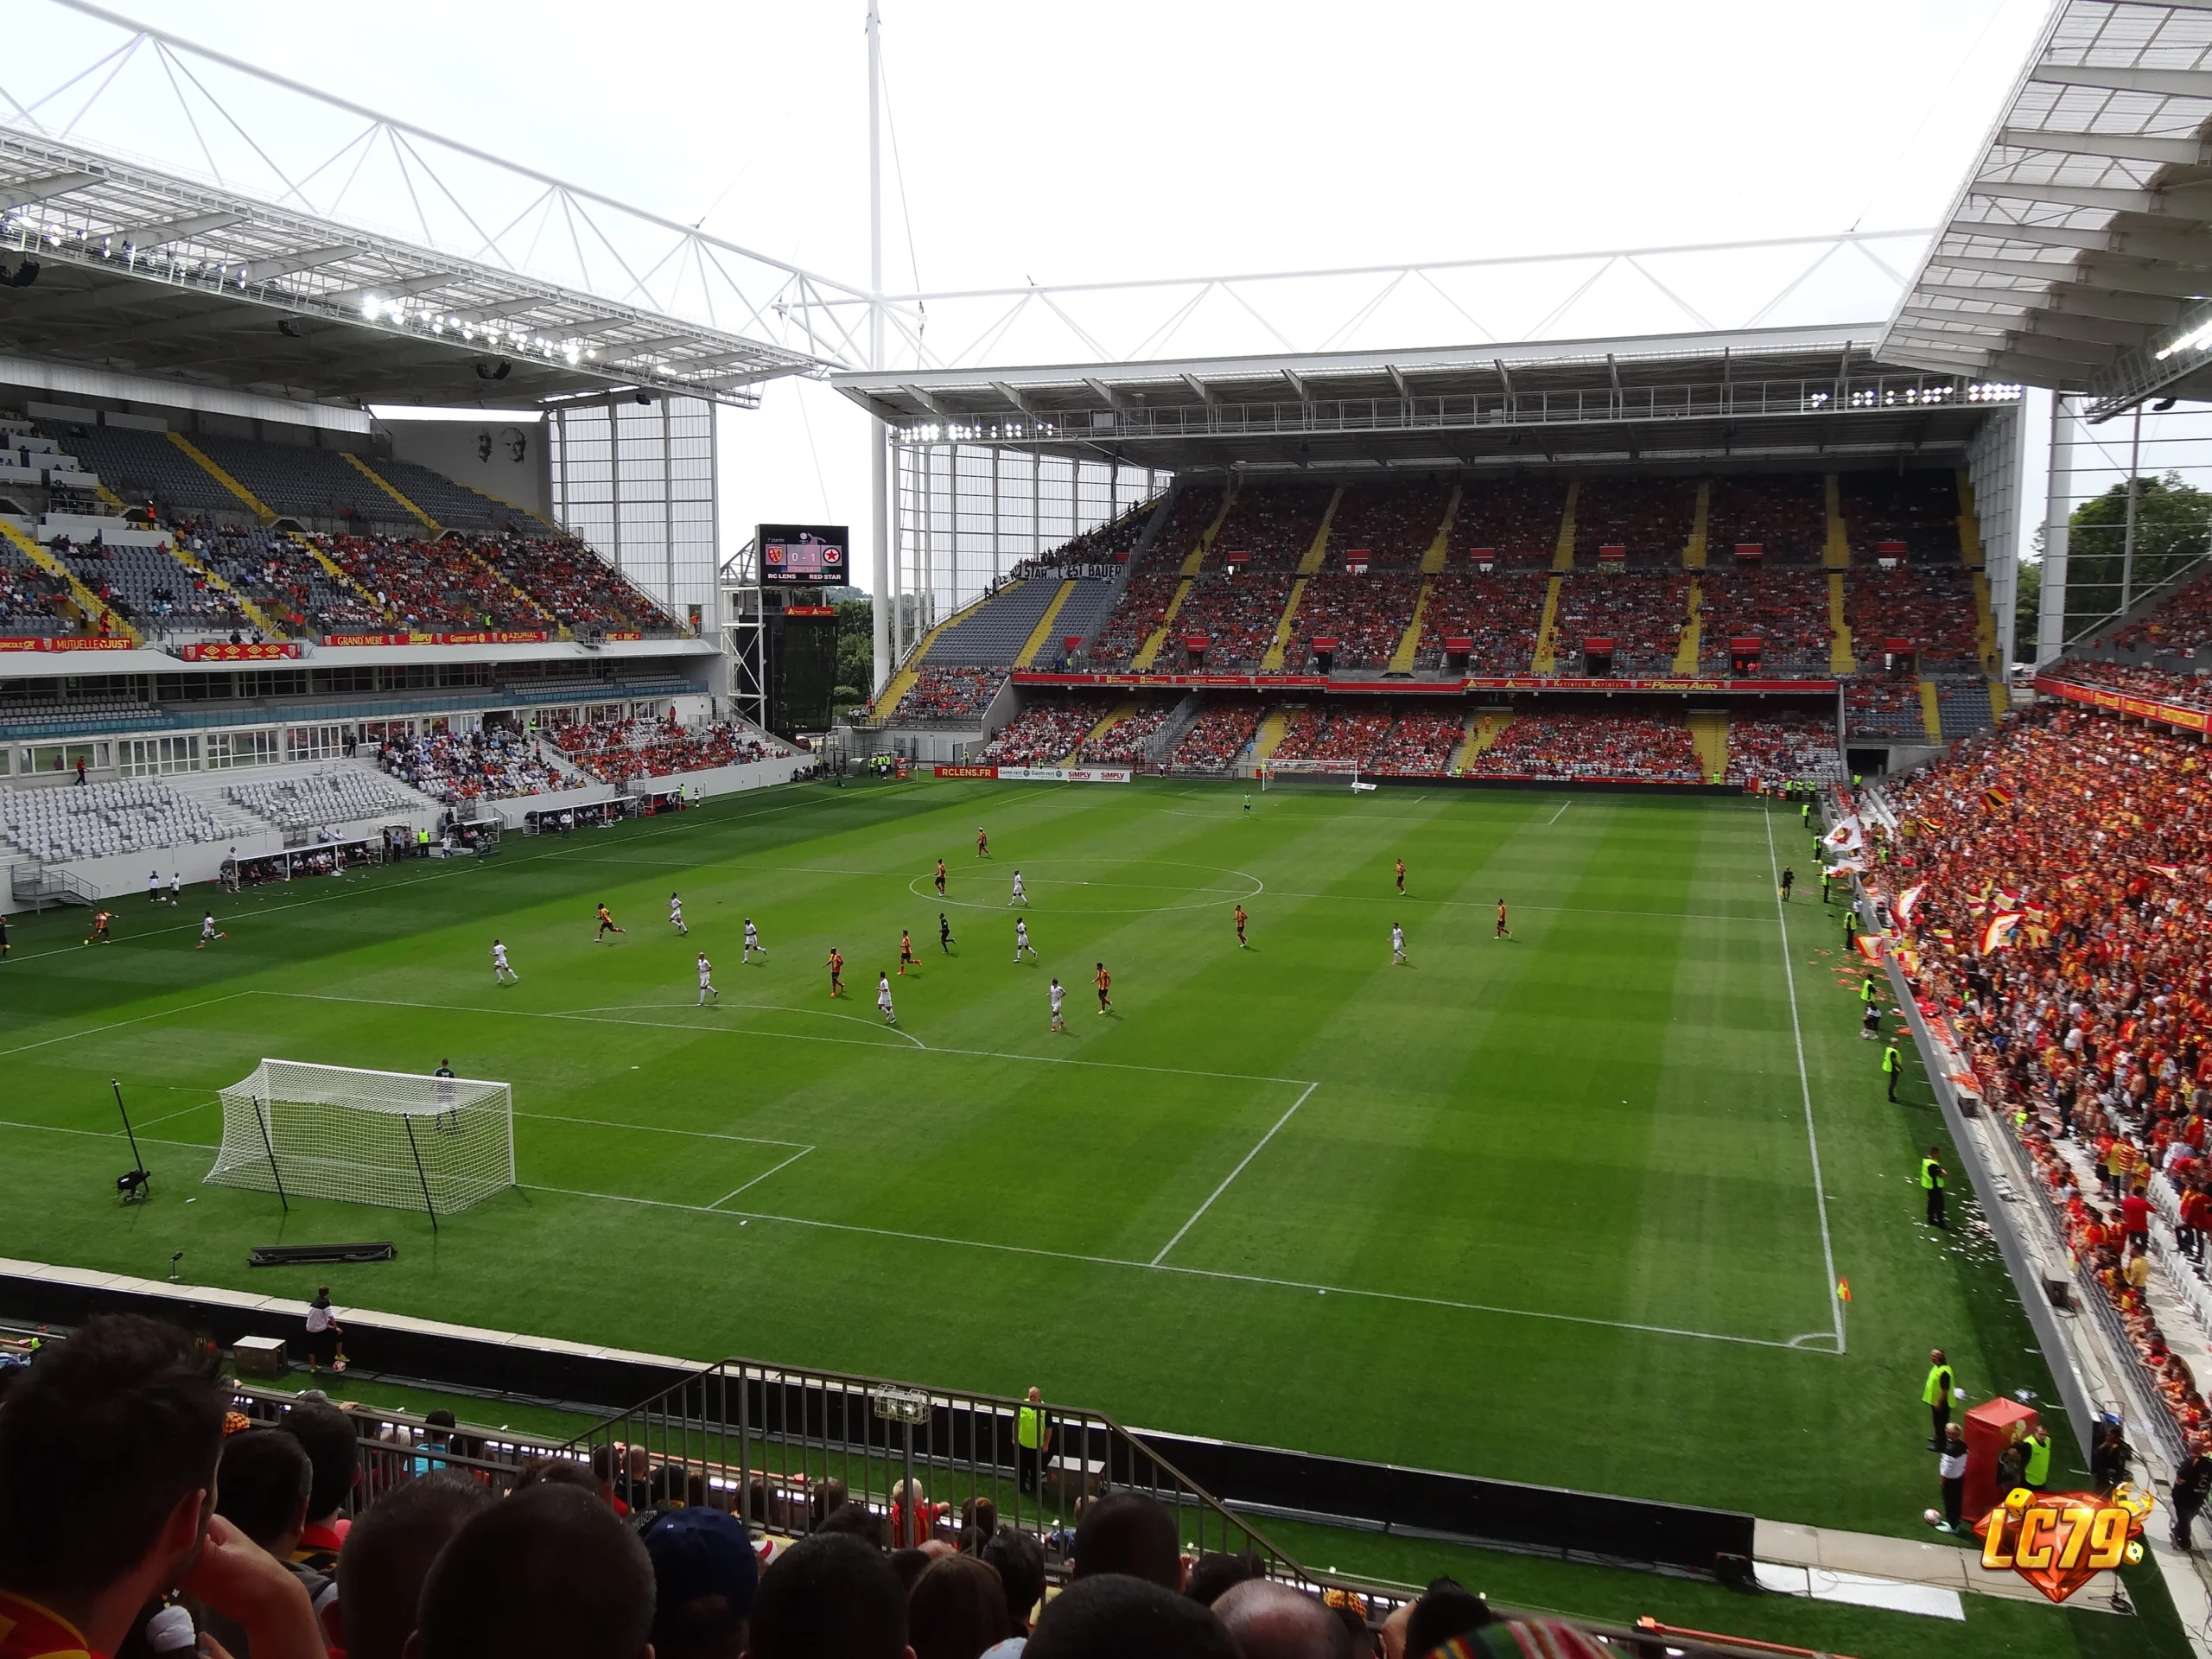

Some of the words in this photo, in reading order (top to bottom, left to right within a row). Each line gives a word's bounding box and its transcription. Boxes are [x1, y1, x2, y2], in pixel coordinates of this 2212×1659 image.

[791, 552, 798, 562] 0
[810, 553, 815, 562] 1
[998, 575, 1008, 585] LE
[1089, 564, 1122, 578] BAUER
[57, 639, 99, 649] MUTUELLE
[1689, 681, 1718, 690] Auto
[942, 768, 991, 777] RCLENS.FR
